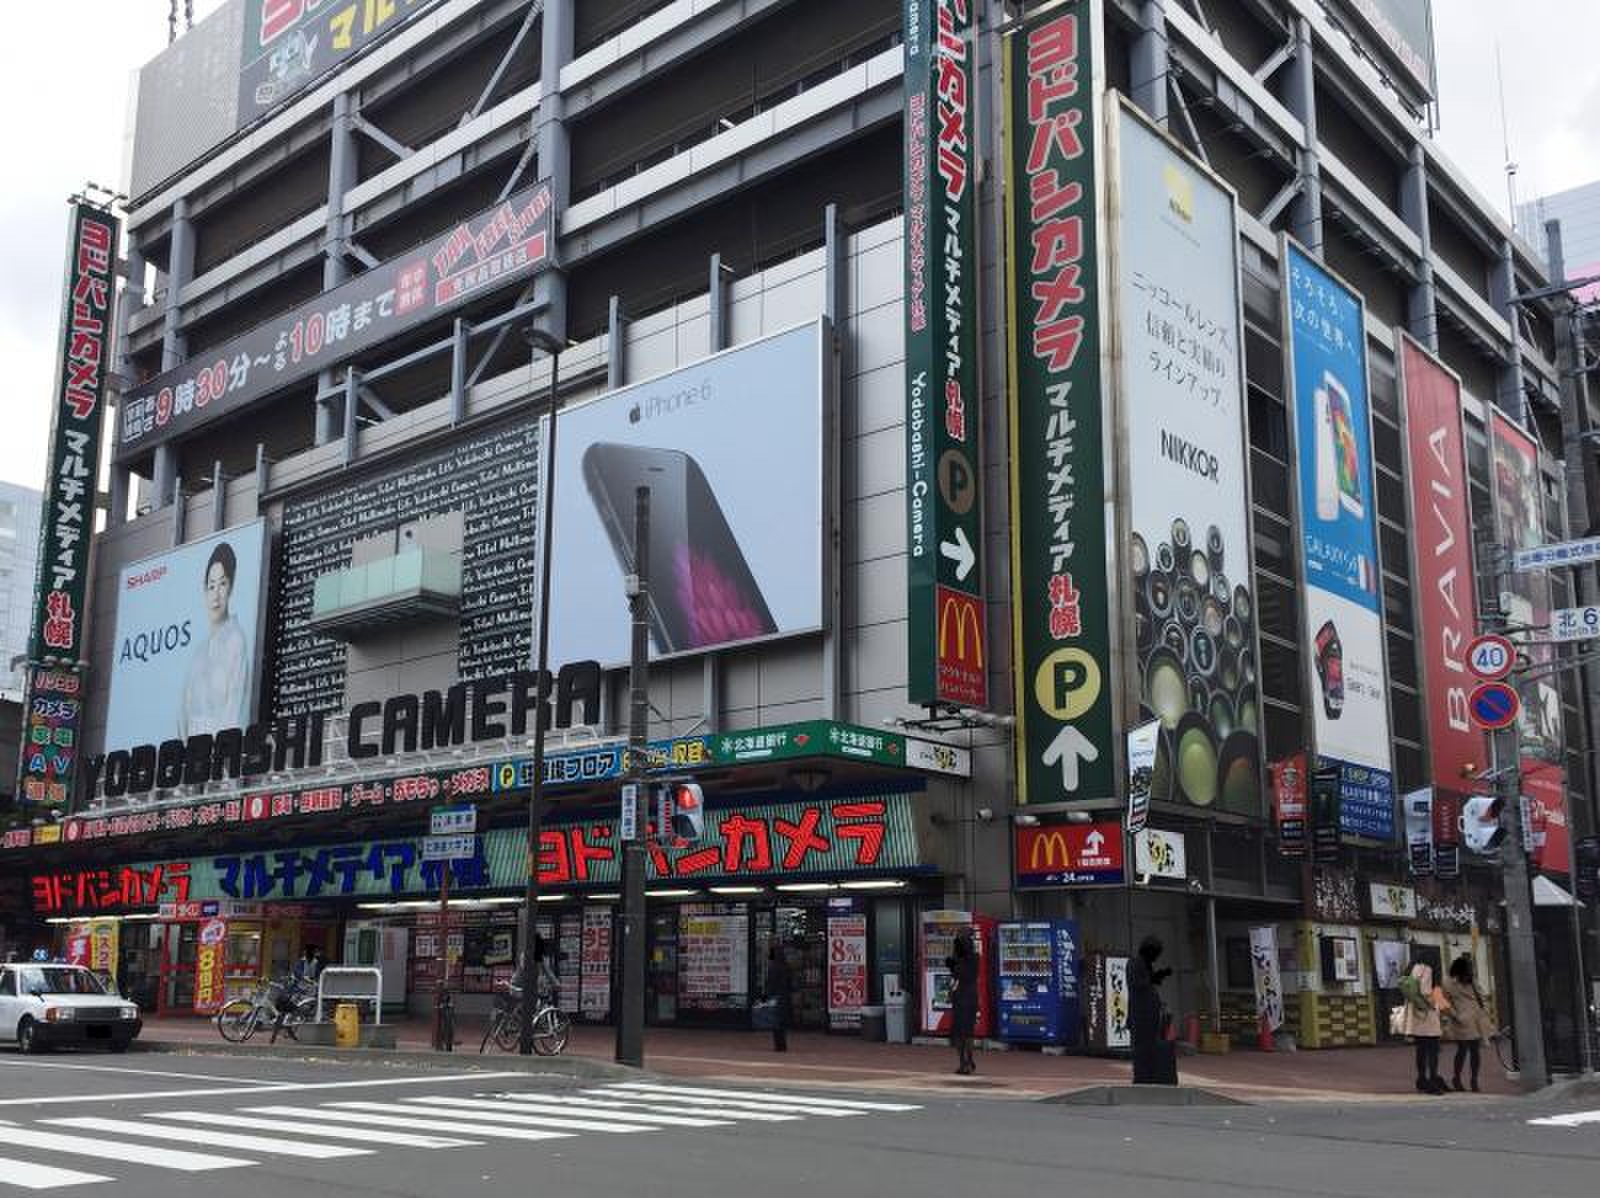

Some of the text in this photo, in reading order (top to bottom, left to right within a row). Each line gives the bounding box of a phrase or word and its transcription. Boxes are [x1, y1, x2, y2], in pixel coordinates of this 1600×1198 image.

[1027, 14, 1086, 373] ヨドバシカメラ
[65, 218, 111, 419] ヨドバシカメラ
[1161, 428, 1219, 485] NIKKOR
[1046, 383, 1081, 640] マルチメディア札幌
[126, 566, 167, 590] SHARP
[1429, 424, 1470, 733] BRAVIA
[119, 620, 192, 664] AQUOS
[1475, 650, 1504, 670] 40
[84, 659, 601, 806] YODOBASHI CAMERA
[32, 863, 191, 912] ヨドバシカメラ
